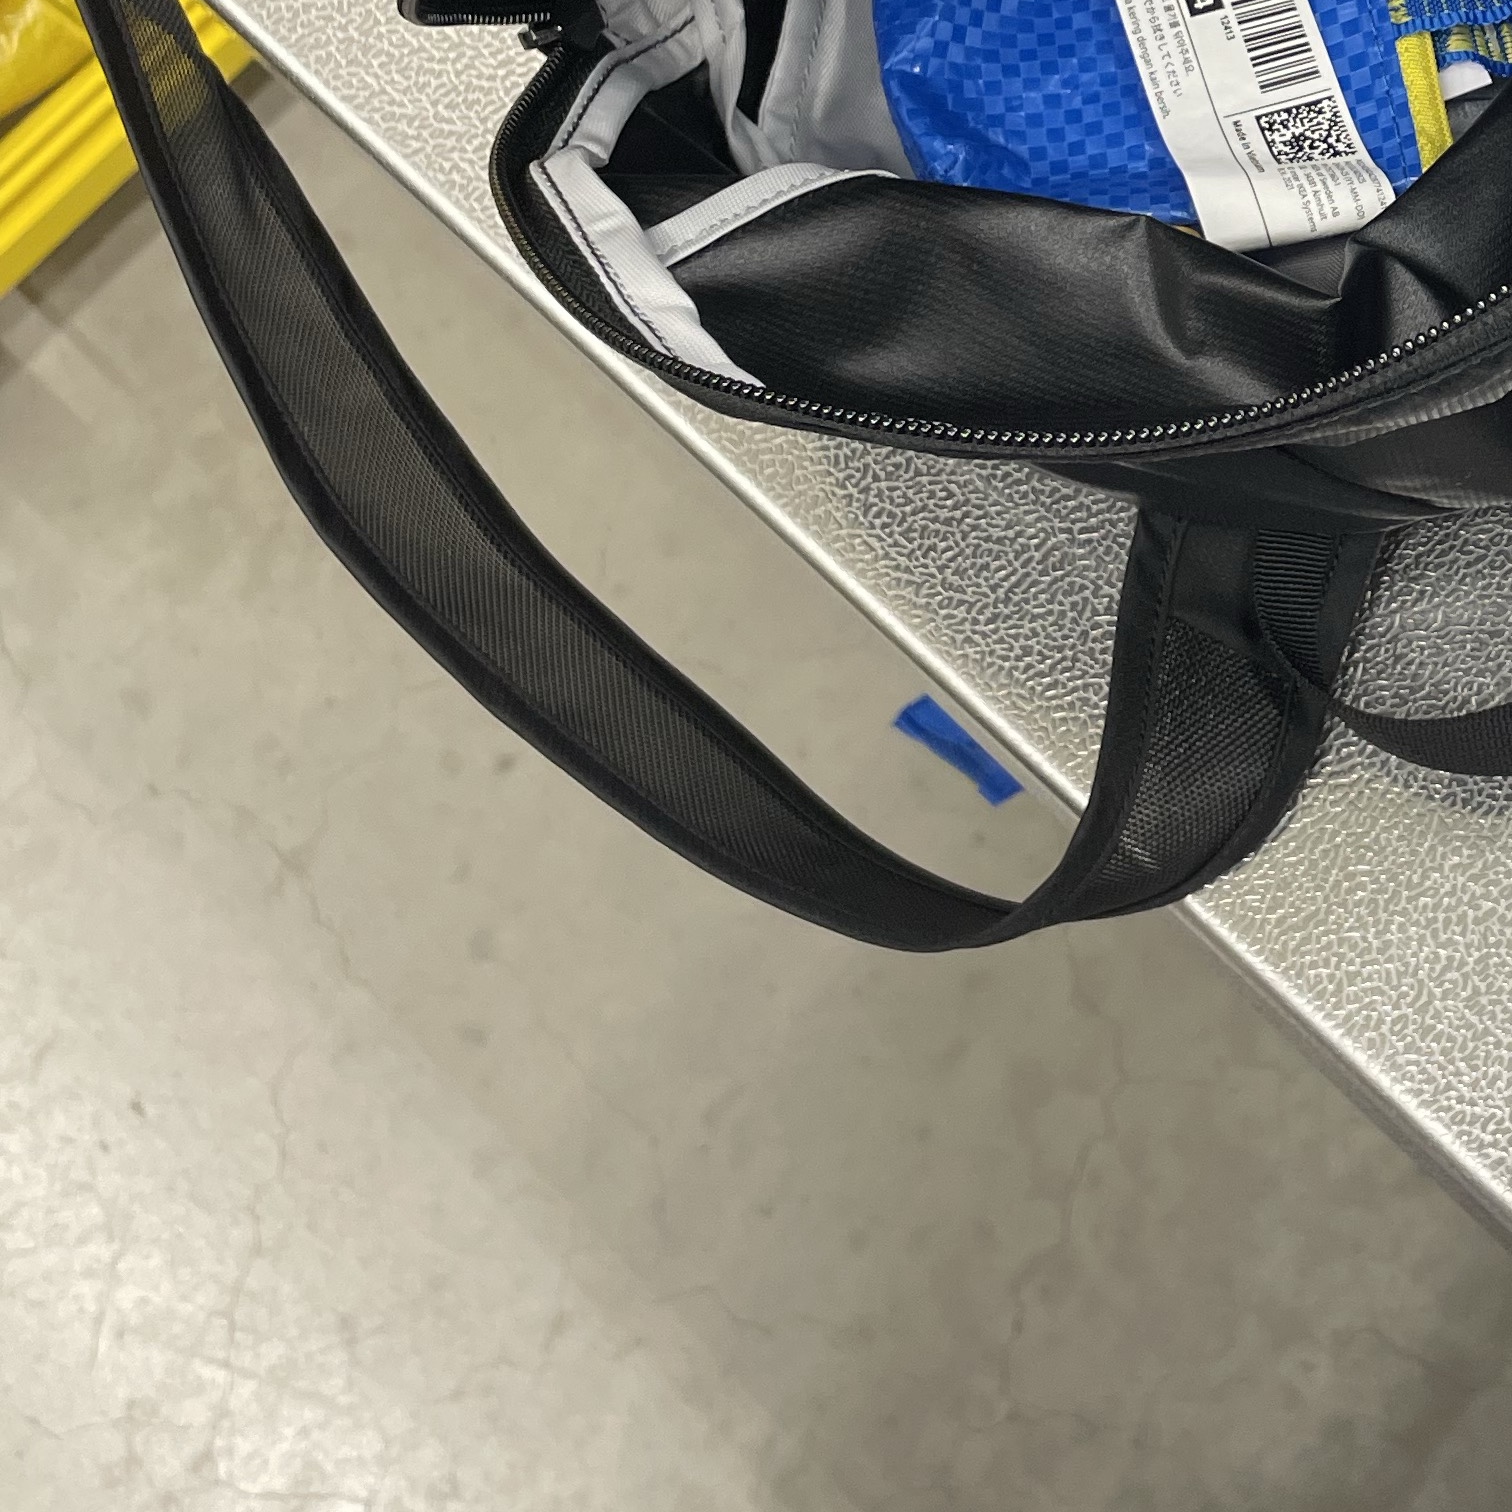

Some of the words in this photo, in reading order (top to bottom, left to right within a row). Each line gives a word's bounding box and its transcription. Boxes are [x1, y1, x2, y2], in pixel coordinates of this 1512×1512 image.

[1219, 14, 1235, 41] 12413
[1126, 4, 1142, 35] kering
[1135, 35, 1153, 70] dengan
[1147, 69, 1160, 90] kain
[1232, 119, 1246, 141] Made
[1240, 141, 1251, 150] in
[1296, 182, 1308, 199] IKEA
[1318, 176, 1335, 205] Sweden
[1329, 205, 1340, 218] AB
[1301, 199, 1318, 234] Systems
